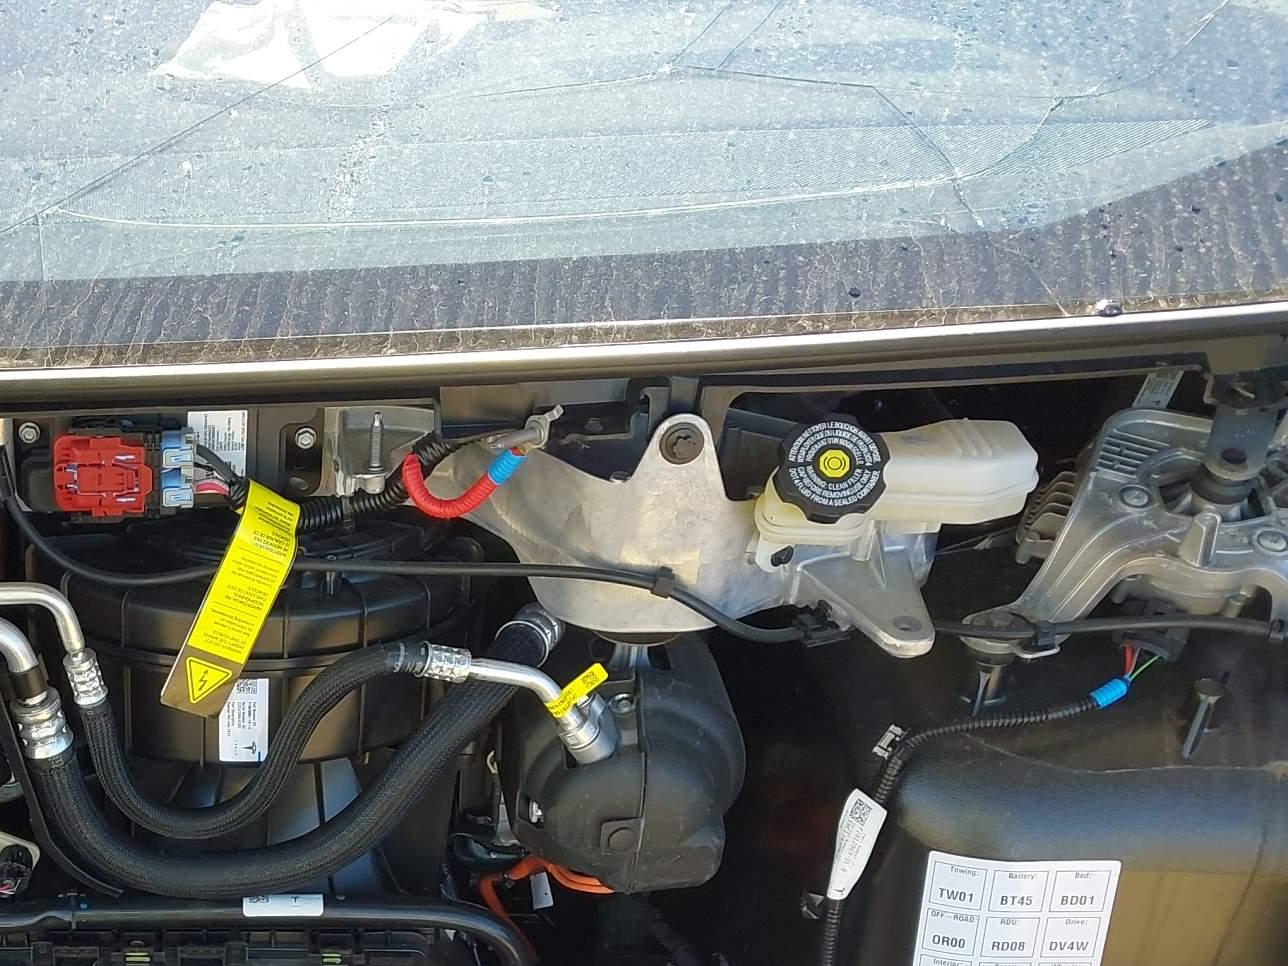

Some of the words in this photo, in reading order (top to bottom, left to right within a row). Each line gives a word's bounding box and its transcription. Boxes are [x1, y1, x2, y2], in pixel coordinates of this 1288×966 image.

[859, 468, 871, 484] ONLY
[827, 481, 848, 490] CLEAN
[795, 481, 812, 498] FLUID
[809, 492, 828, 506] FROM
[951, 866, 980, 876] Towing:
[939, 888, 974, 903] TW01
[1061, 895, 1095, 905] BD01
[1000, 896, 1033, 906] BT45
[991, 941, 1025, 951] RD08
[1049, 941, 1089, 951] DV4W
